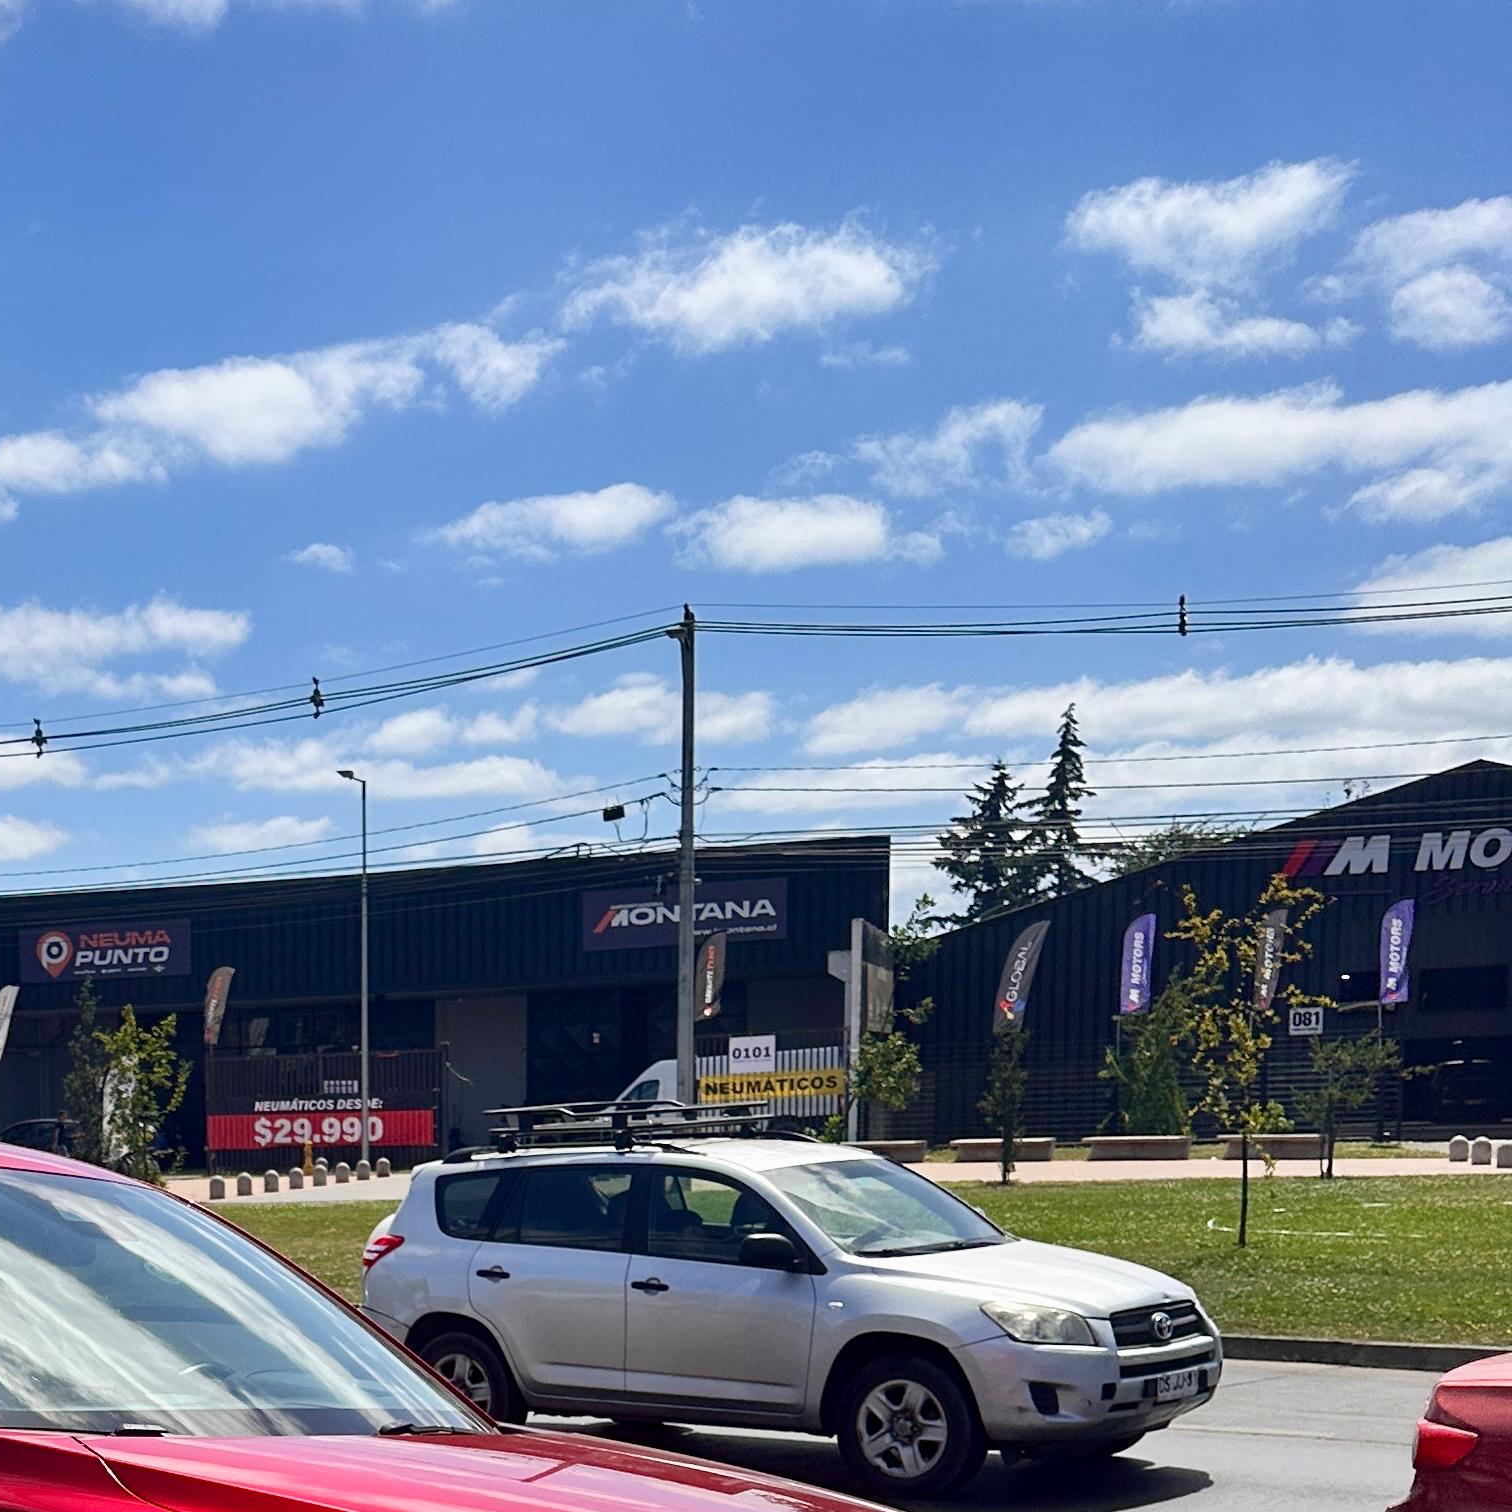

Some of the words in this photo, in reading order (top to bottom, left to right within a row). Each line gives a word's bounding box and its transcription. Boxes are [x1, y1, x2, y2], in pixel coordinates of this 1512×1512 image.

[79, 929, 171, 948] NEUMA
[1388, 918, 1403, 974] MOTORS
[75, 946, 170, 967] PUNTO
[1130, 931, 1145, 985] MOTORS
[1292, 1011, 1320, 1028] 081
[731, 1046, 772, 1060] 0101
[704, 1075, 838, 1096] NEUMÁTICOS
[254, 1098, 335, 1112] NEUMÁTICOS
[253, 1116, 385, 1146] $29.990
